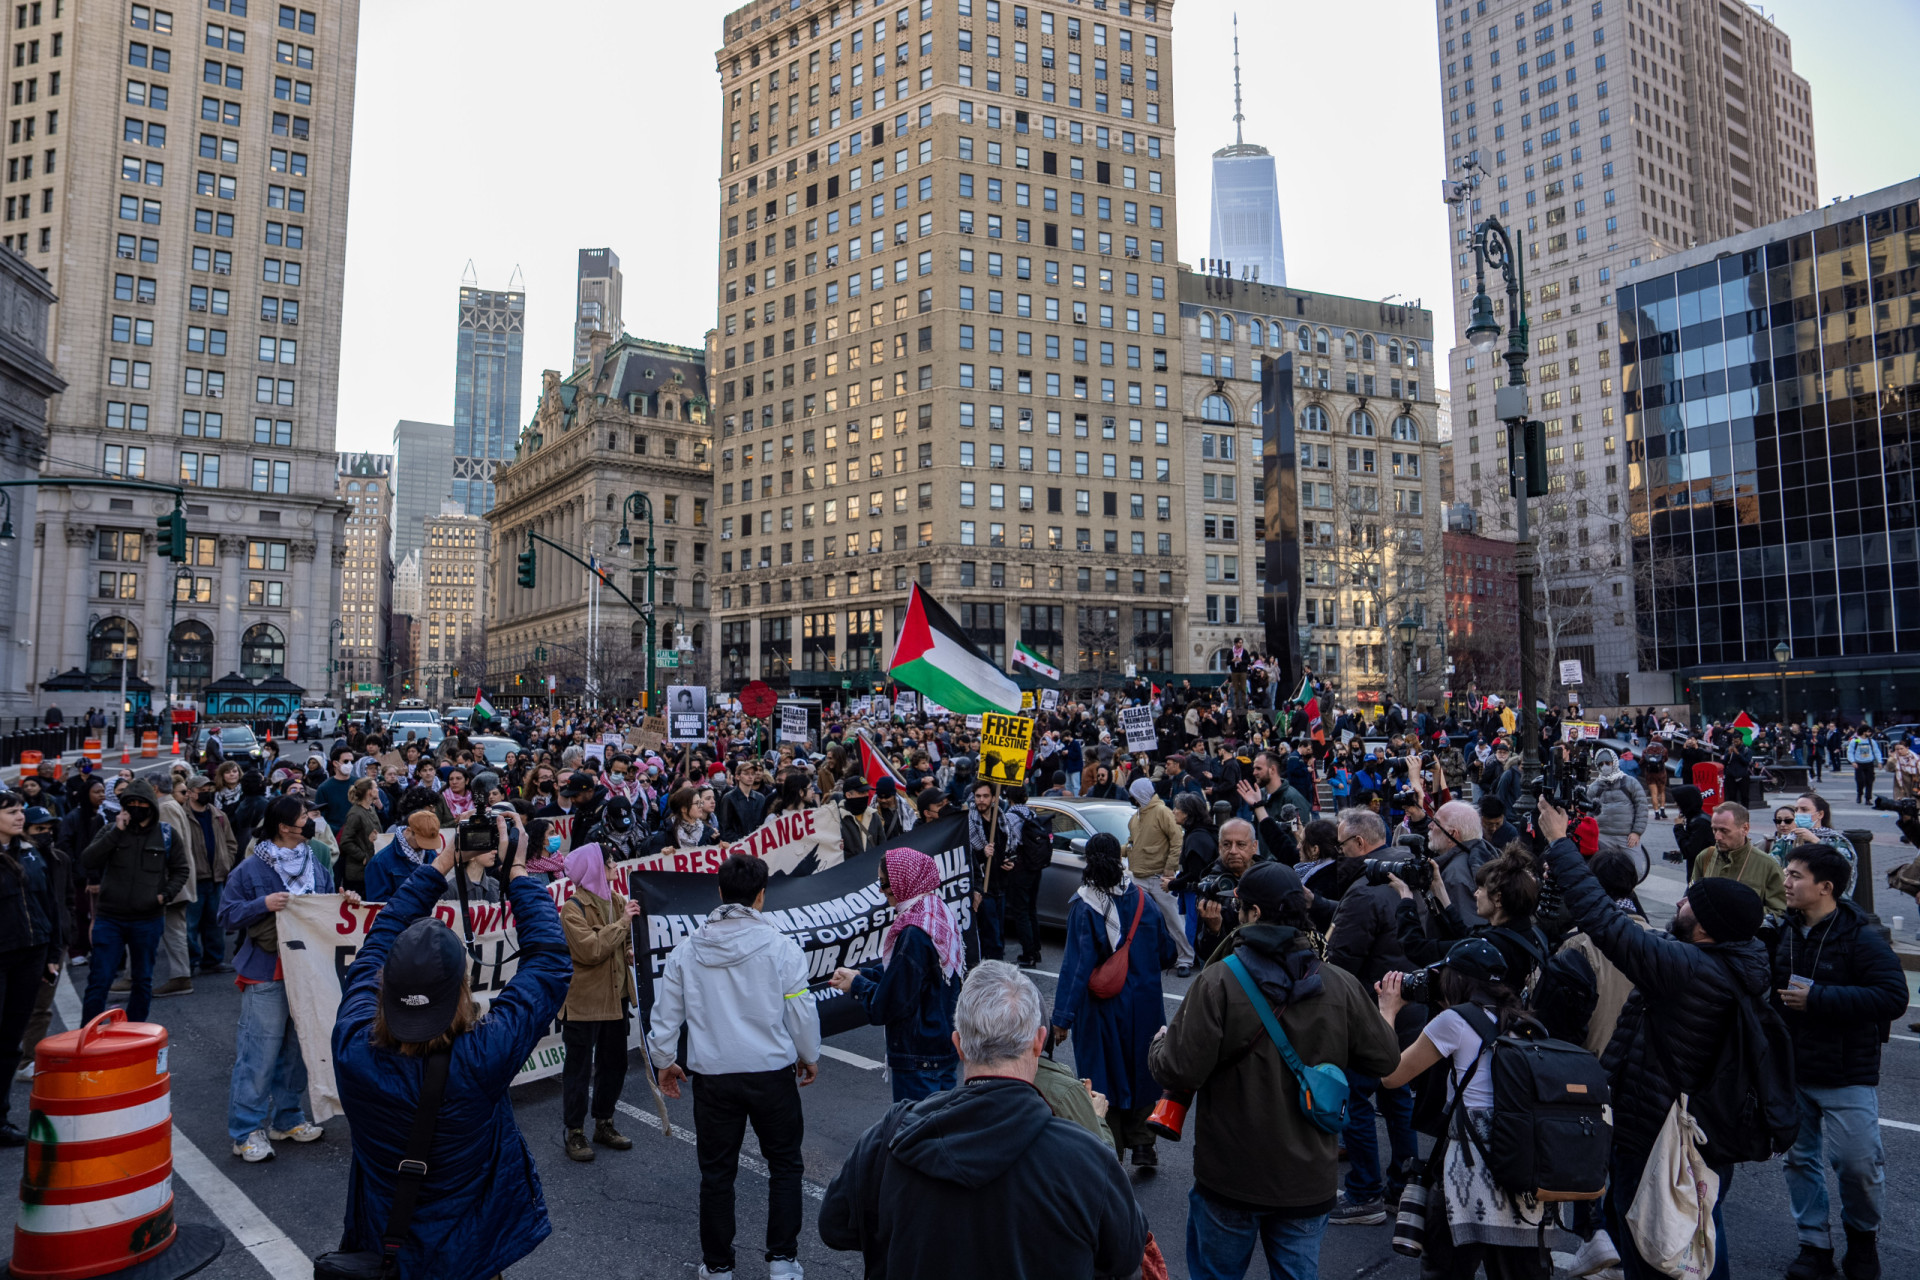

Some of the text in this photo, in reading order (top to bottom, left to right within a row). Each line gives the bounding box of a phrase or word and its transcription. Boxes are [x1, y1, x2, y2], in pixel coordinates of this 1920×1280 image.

[783, 706, 806, 716] RELEASE
[1123, 707, 1150, 718] RELEASE
[677, 714, 699, 722] RELEASE
[1124, 716, 1151, 724] MAHMOUD
[985, 714, 1030, 739] FREE
[1127, 730, 1144, 738] HANDS
[1136, 735, 1154, 743] STUDENTS
[982, 734, 1029, 750] PALESTINE
[816, 916, 869, 944] OUR
